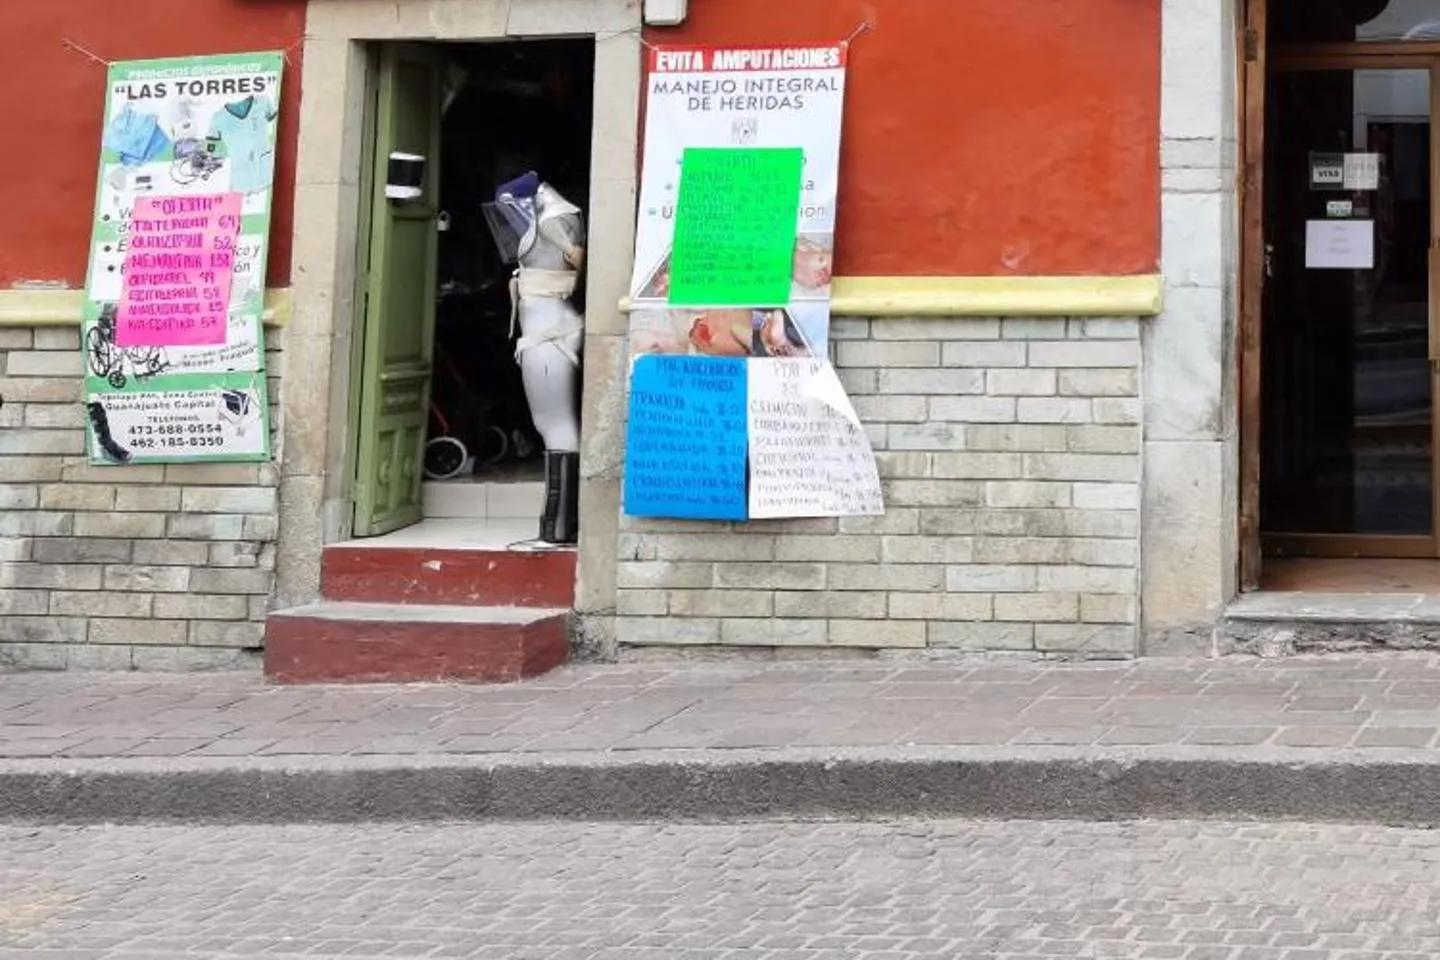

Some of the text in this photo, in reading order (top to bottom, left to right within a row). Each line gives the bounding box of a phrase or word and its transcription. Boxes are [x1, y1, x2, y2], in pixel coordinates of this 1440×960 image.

[656, 47, 840, 71] EVITA AMPUTACIONES
[653, 76, 839, 95] MANEJO INTEGRAL
[688, 95, 804, 112] DE HERIDAS
[105, 399, 217, 414] Guanajuato Capital
